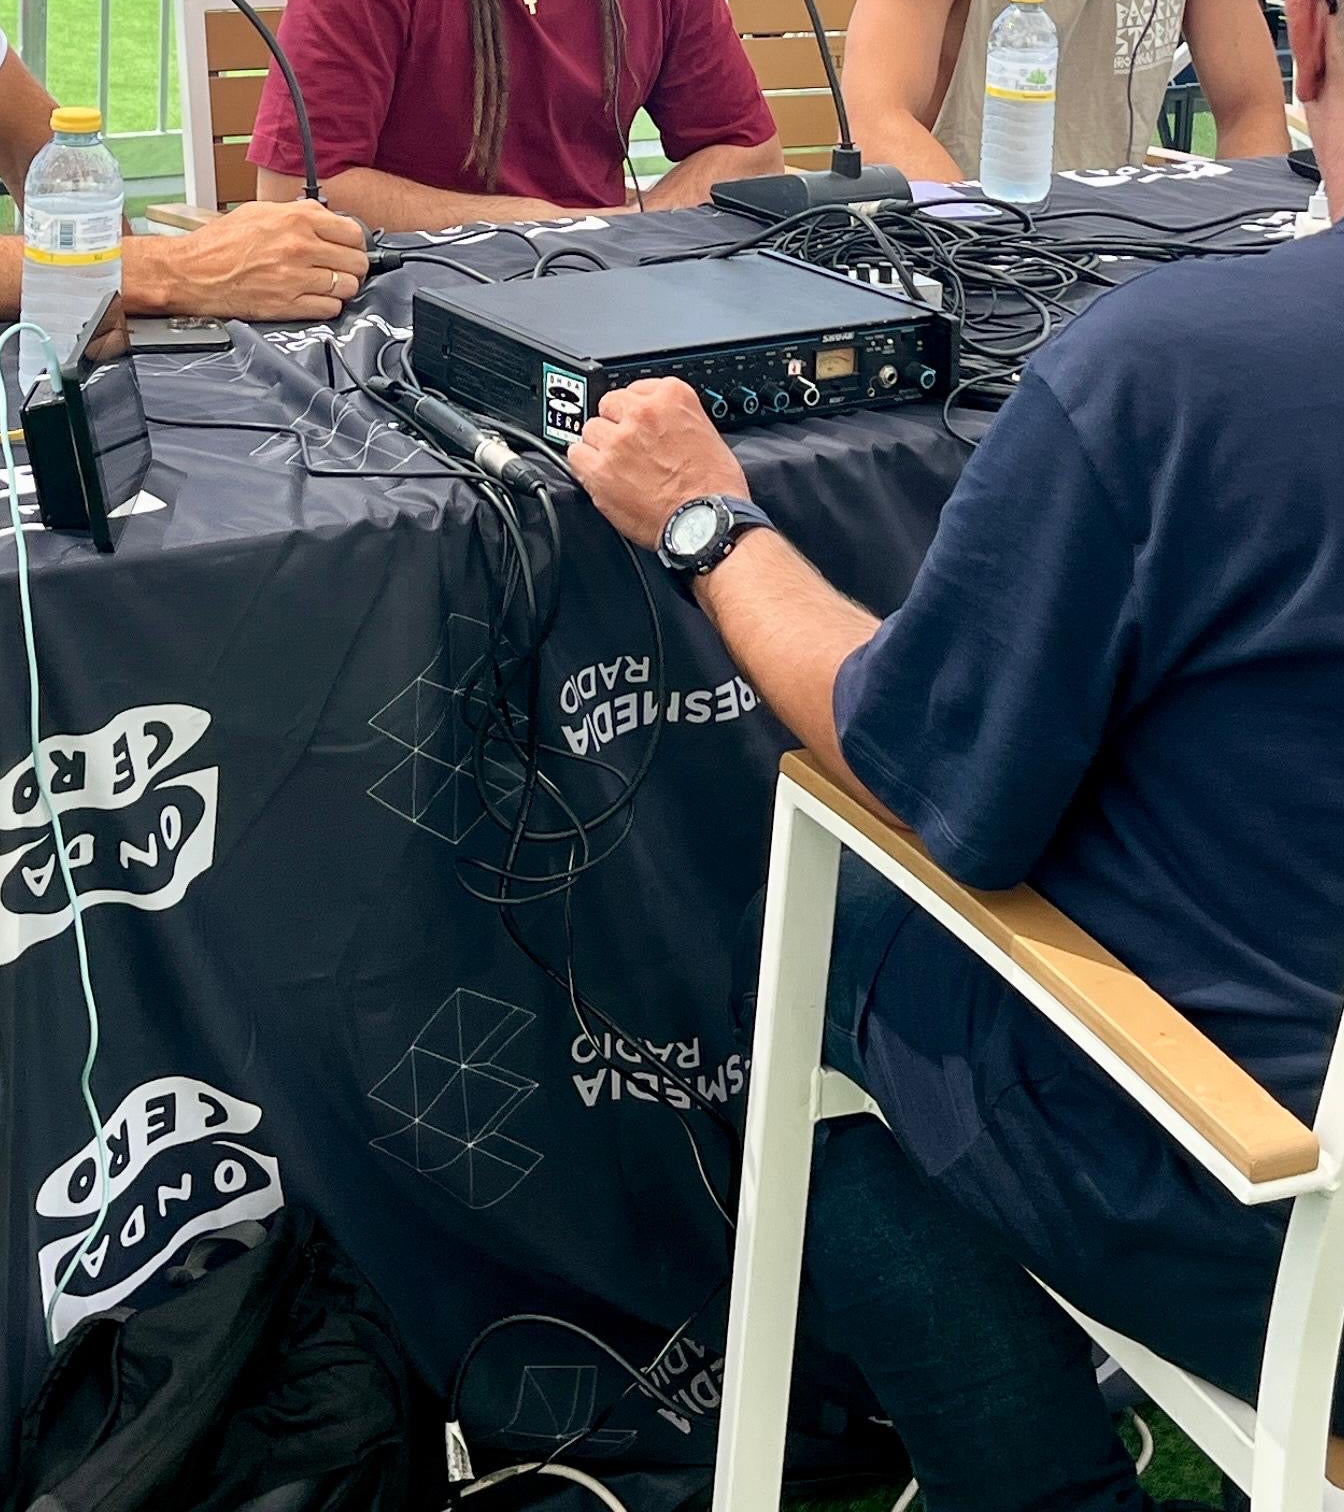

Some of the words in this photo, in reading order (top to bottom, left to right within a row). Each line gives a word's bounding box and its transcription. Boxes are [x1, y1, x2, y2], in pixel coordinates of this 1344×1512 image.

[547, 410, 580, 432] CERO
[549, 374, 580, 389] ONDA
[560, 656, 650, 714] RADIO
[12, 720, 174, 815] CERO
[21, 804, 183, 897] ONDA
[67, 1091, 229, 1204] CERO
[80, 1158, 248, 1279] ONDA
